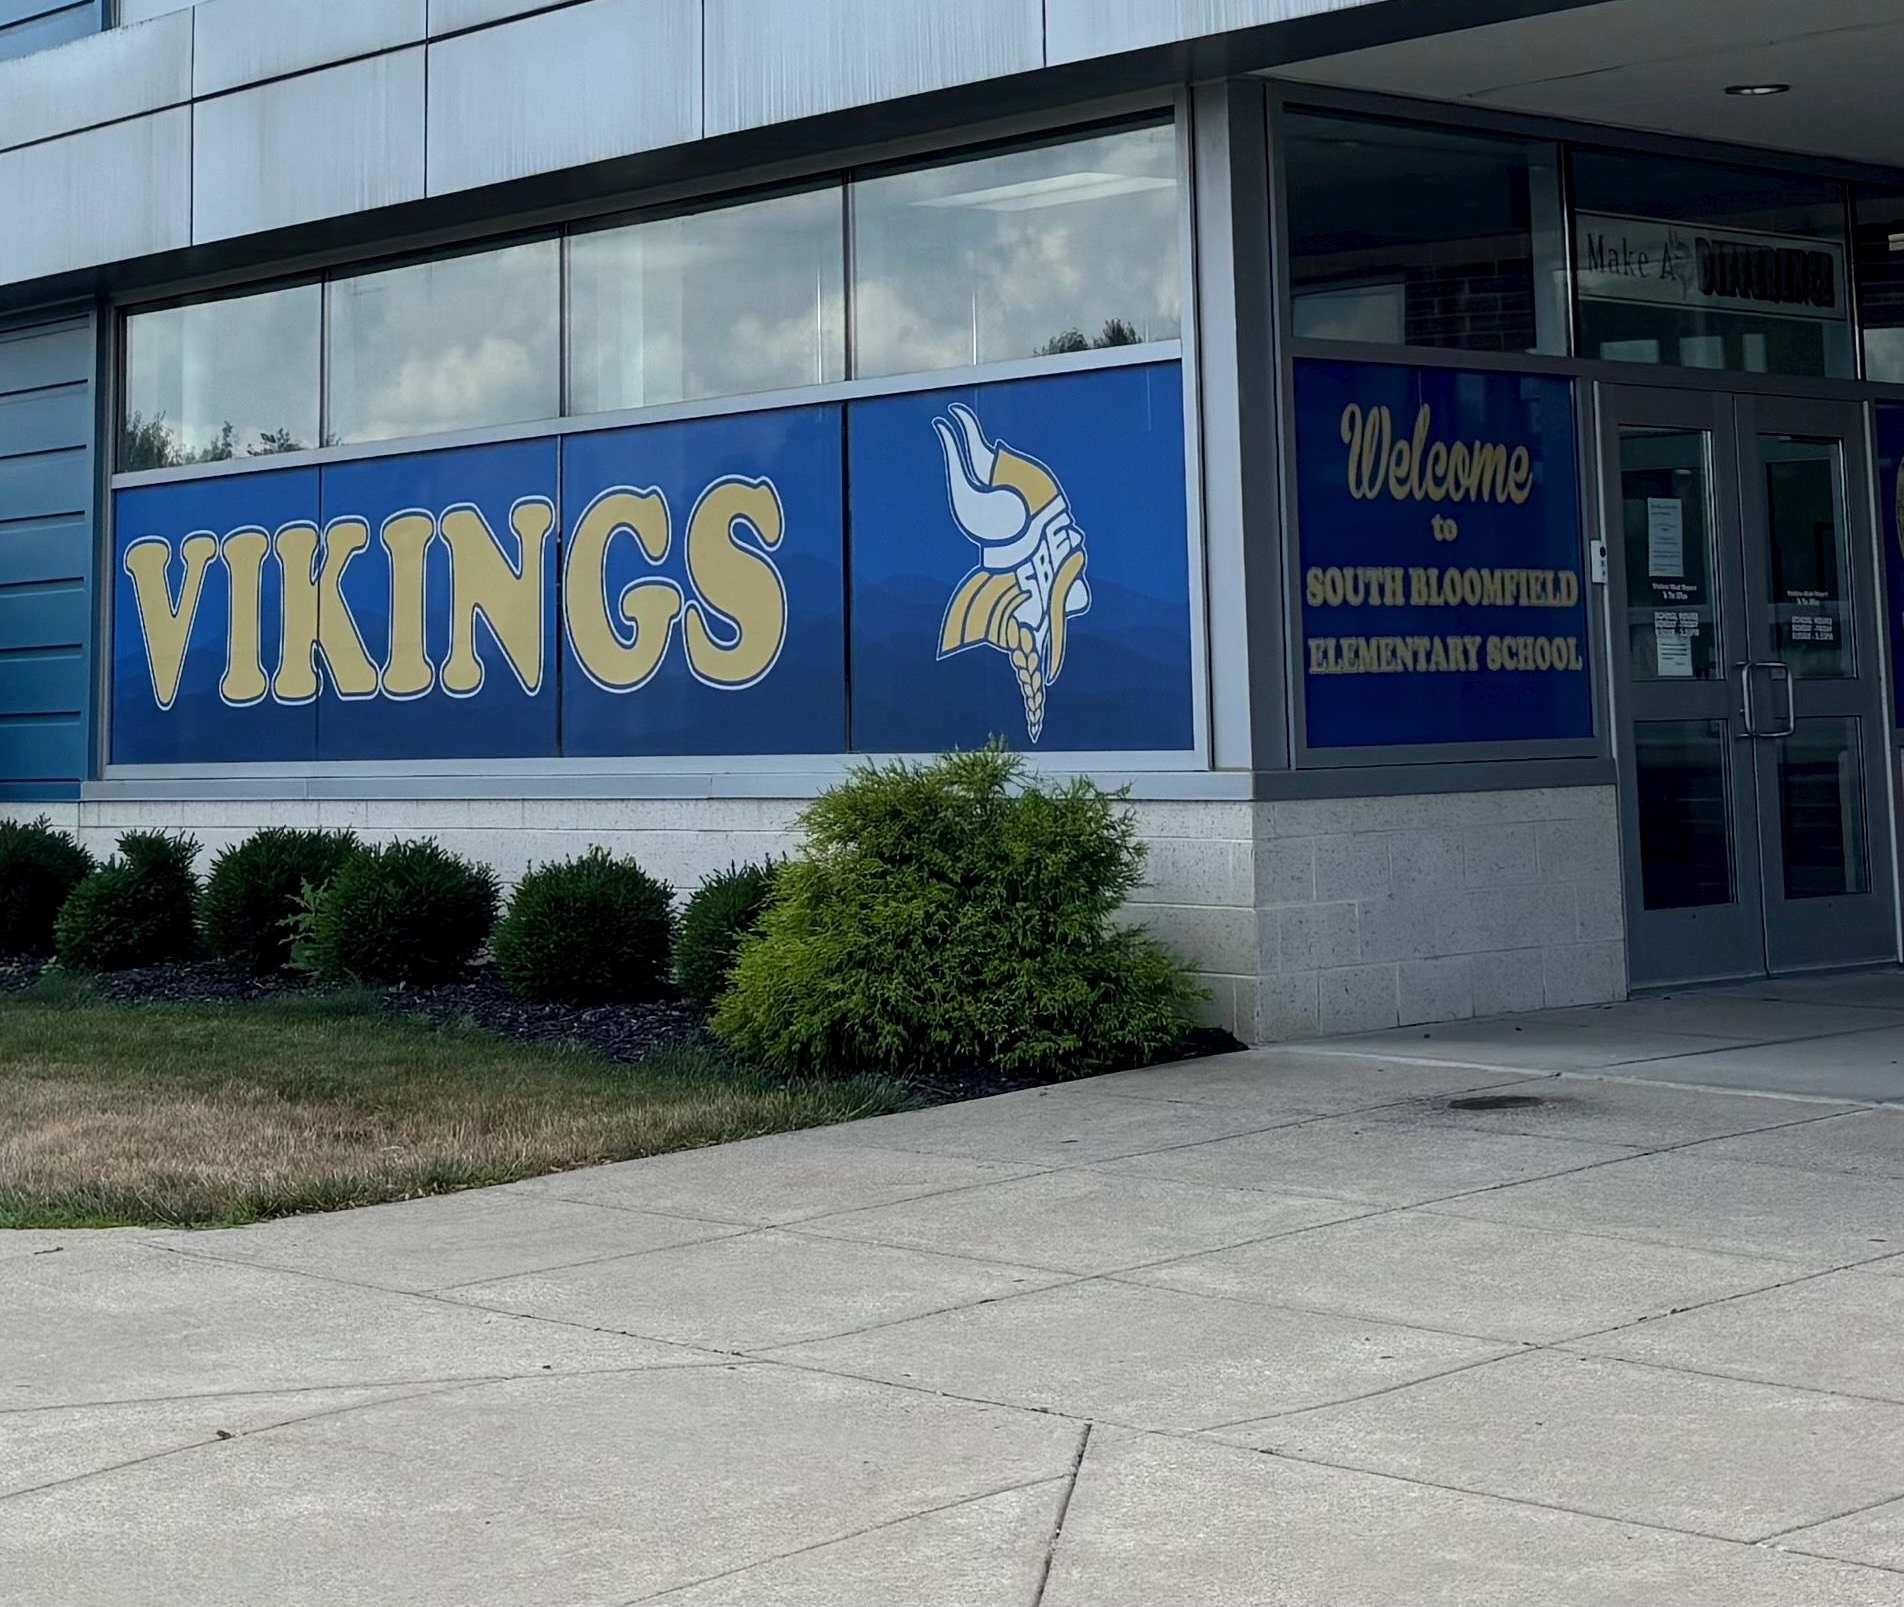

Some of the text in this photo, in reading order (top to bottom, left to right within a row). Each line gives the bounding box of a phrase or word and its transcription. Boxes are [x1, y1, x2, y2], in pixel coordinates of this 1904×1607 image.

[1587, 233, 1649, 280] Make
[1658, 242, 1678, 281] A
[1339, 402, 1534, 505] Welcome
[1430, 512, 1459, 543] to
[123, 472, 788, 712] VIKINGS
[1012, 512, 1077, 630] SBE
[1305, 565, 1580, 609] SOUTH BLOOMFIELD
[1307, 636, 1583, 675] ELEMENTARY SCHOOL
